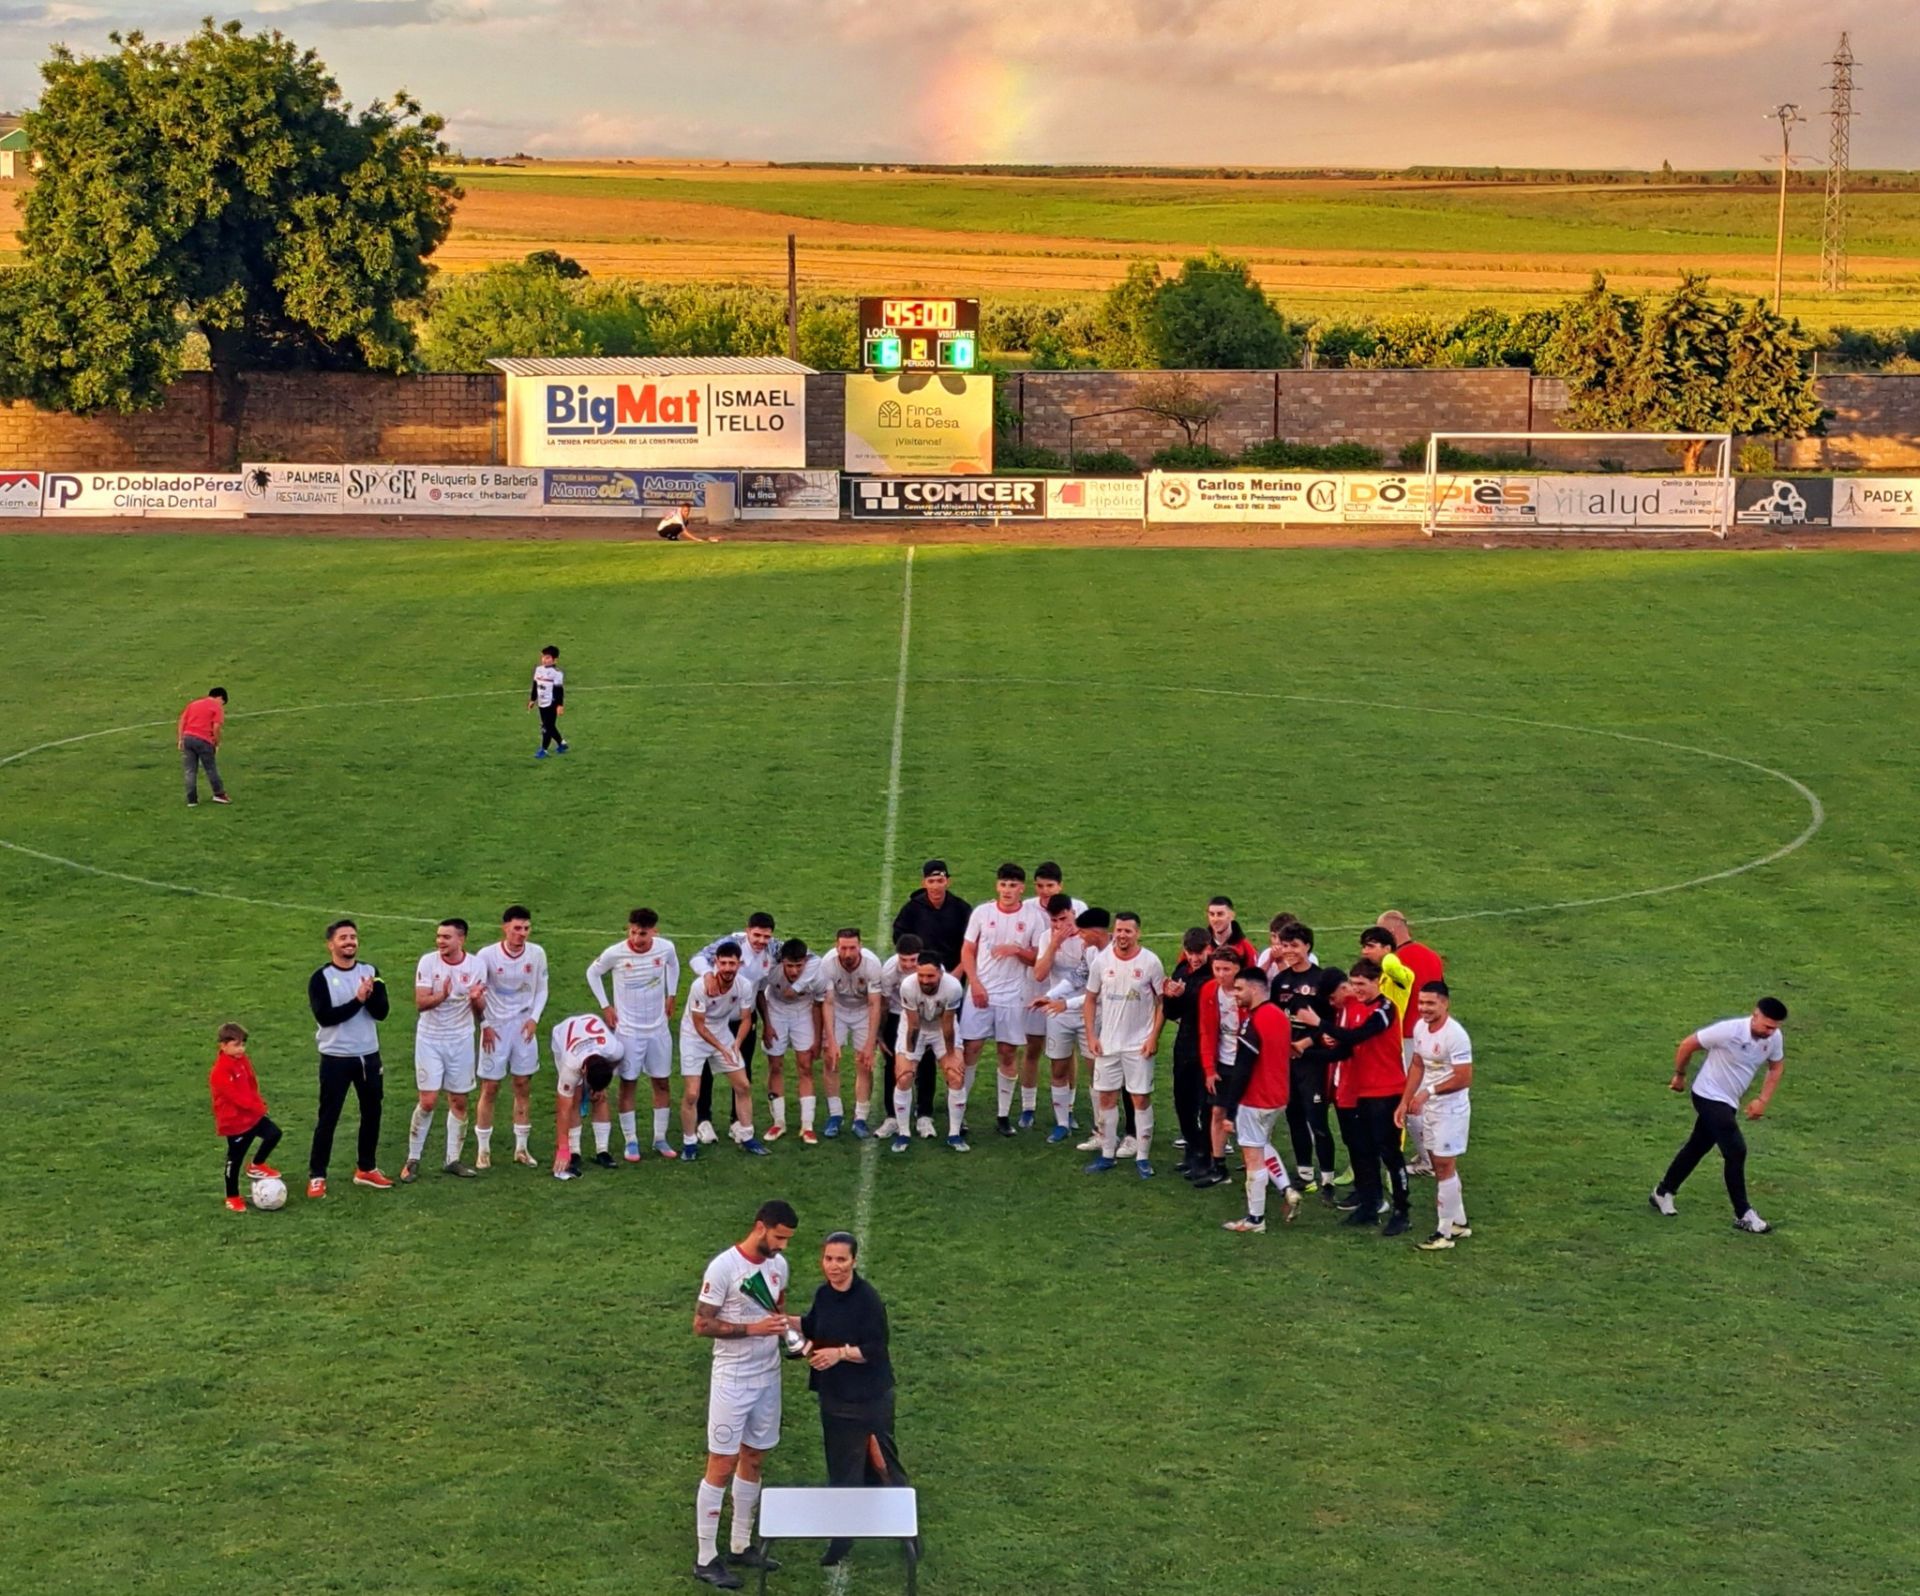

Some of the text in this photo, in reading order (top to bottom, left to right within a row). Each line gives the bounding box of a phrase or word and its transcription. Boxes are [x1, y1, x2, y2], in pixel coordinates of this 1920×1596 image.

[866, 328, 899, 338] LOCAL
[937, 330, 975, 339] VISITANTE
[912, 339, 926, 360] 2
[903, 360, 935, 368] PERIODO
[715, 390, 795, 407] ISMAEL
[547, 384, 700, 435] BigMat
[907, 404, 942, 416] Finca
[715, 414, 784, 431] TELLO
[906, 417, 960, 429] La Desa
[286, 470, 341, 484] PALMERA
[92, 476, 243, 492] Dr. Doblado Pérez
[550, 482, 599, 498] Momo
[1090, 481, 1141, 491] Retales
[1197, 478, 1302, 491] Carlos Merino
[276, 491, 338, 504] RESTAURANTE
[904, 482, 1036, 503] COMICER
[1863, 490, 1913, 503] PADEX
[114, 494, 217, 509] Clínica Dental
[1090, 496, 1142, 508] Hipólito
